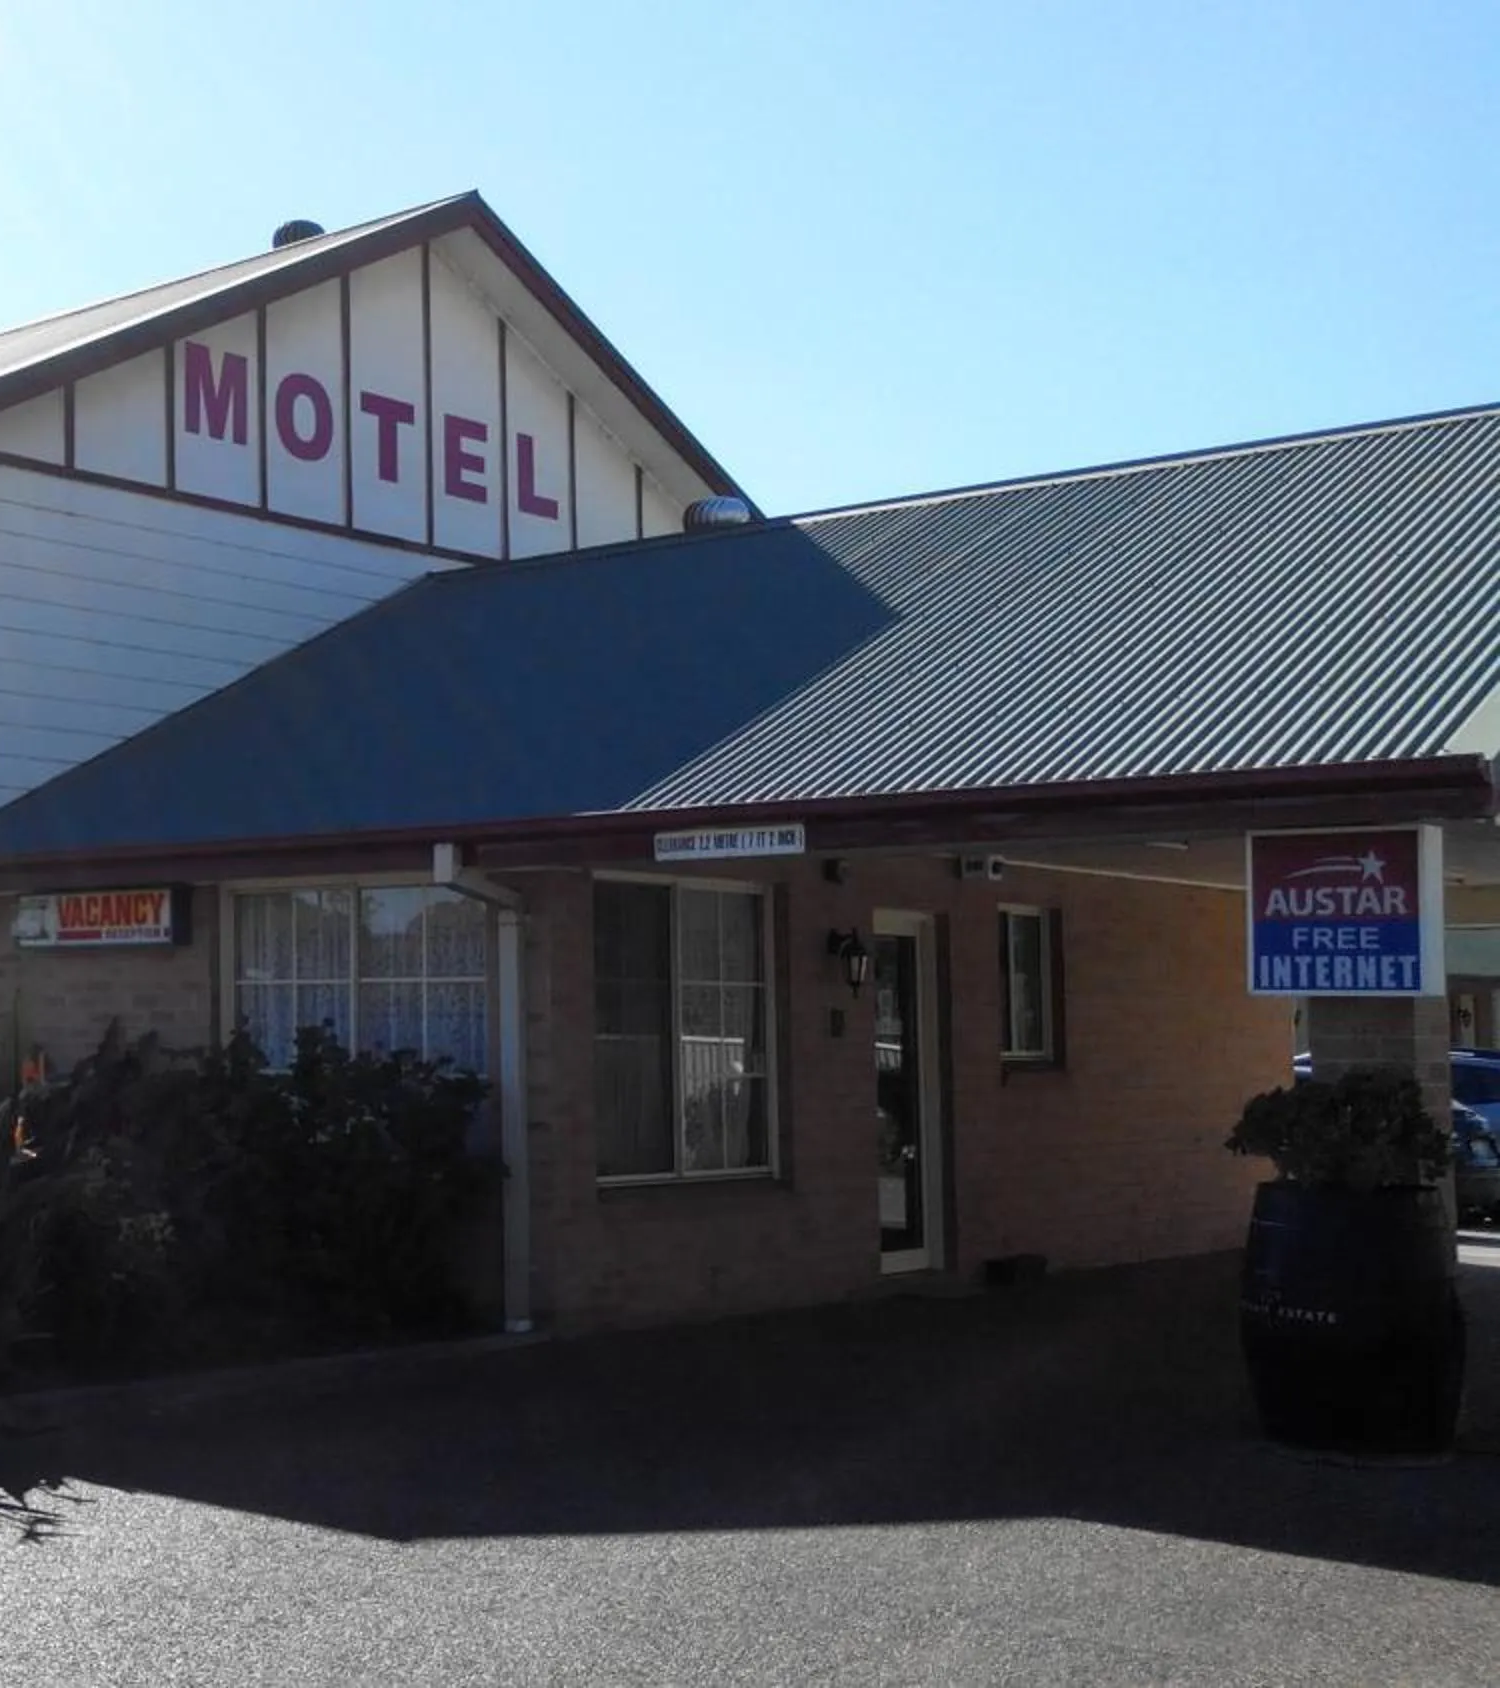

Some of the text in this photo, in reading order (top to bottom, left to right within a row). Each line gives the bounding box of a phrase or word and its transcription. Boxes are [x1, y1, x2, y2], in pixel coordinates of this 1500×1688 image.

[184, 340, 559, 520] MOTEL
[58, 893, 165, 928] VACANCY
[1264, 885, 1408, 917] AUSTAR
[1292, 926, 1381, 950] FREE
[1260, 954, 1417, 989] INTERNET
